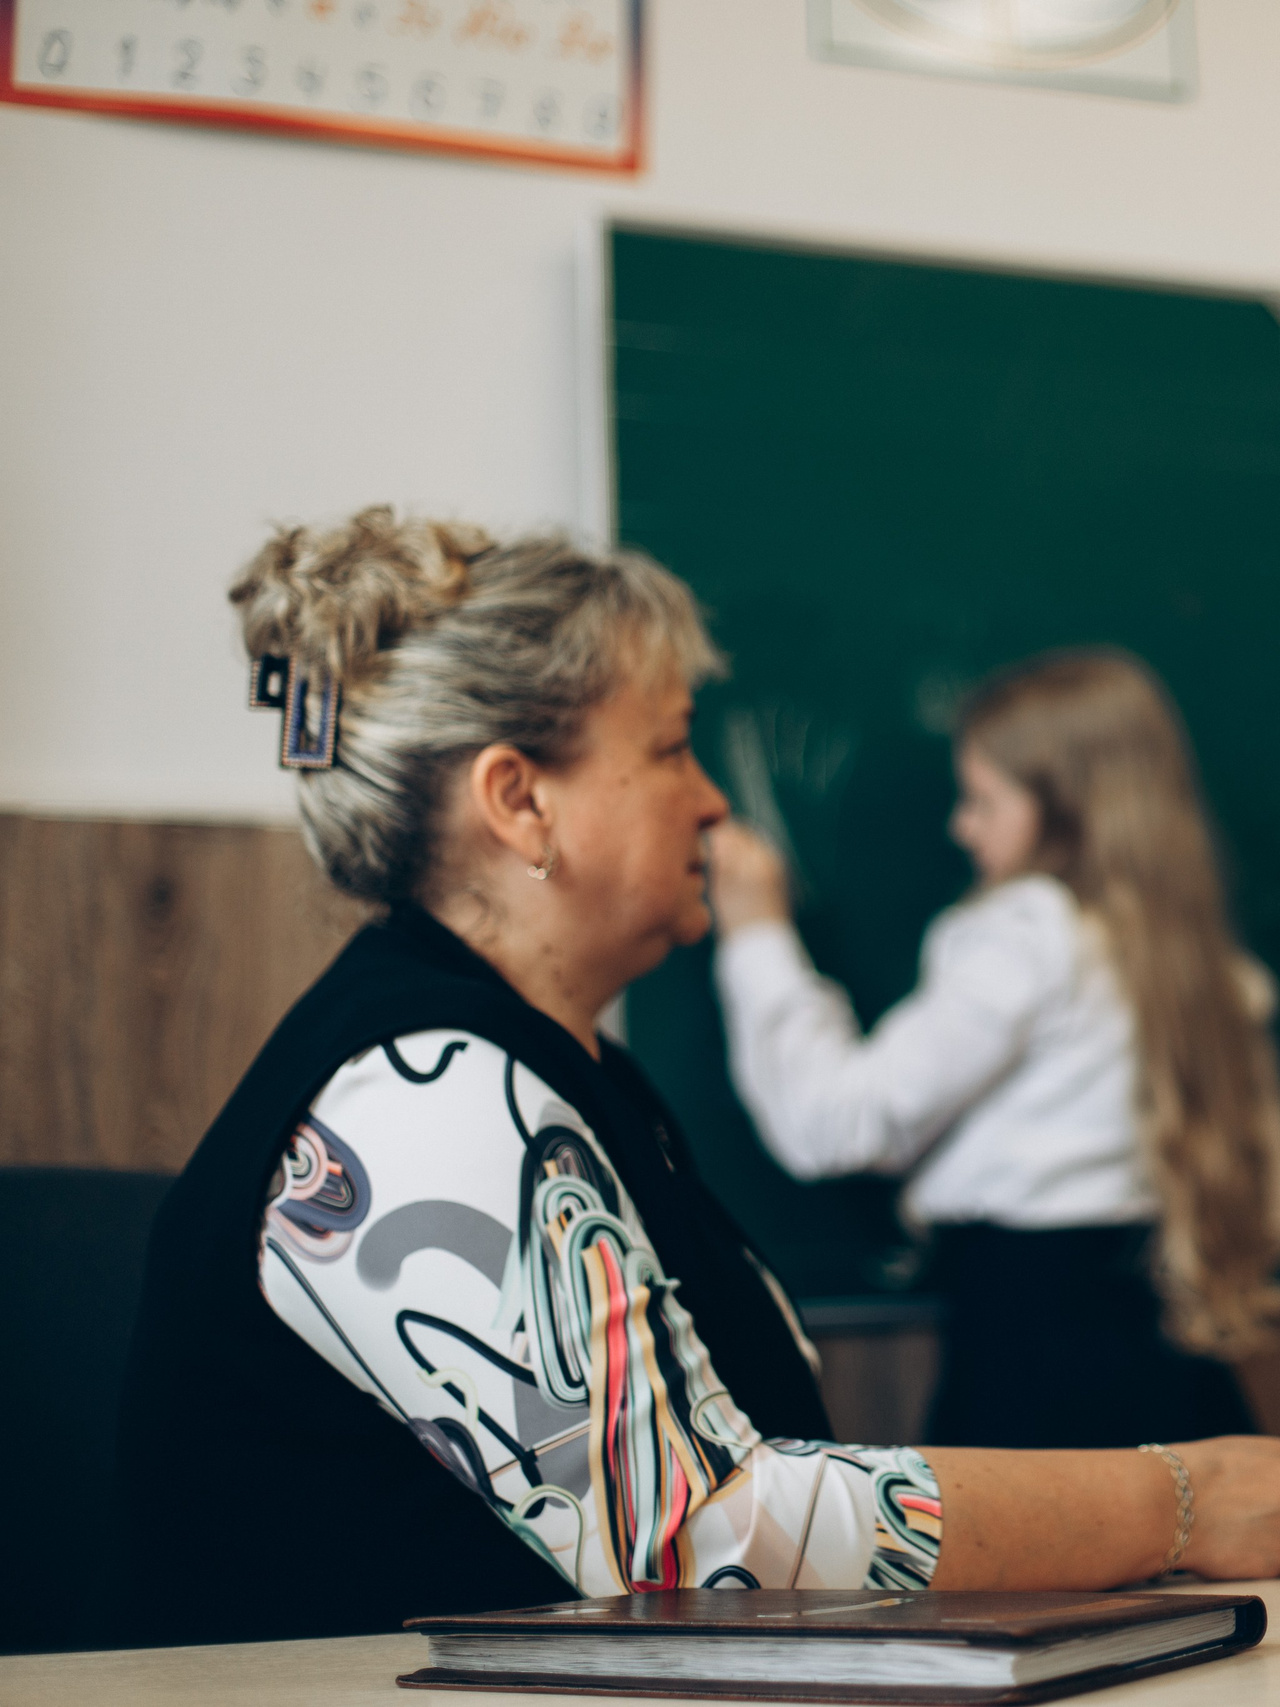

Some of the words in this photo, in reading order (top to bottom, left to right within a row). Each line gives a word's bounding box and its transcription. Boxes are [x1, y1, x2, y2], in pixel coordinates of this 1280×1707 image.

[38, 29, 73, 76] 0
[116, 34, 138, 80] 1
[173, 39, 203, 88] 2
[236, 44, 266, 95] 3
